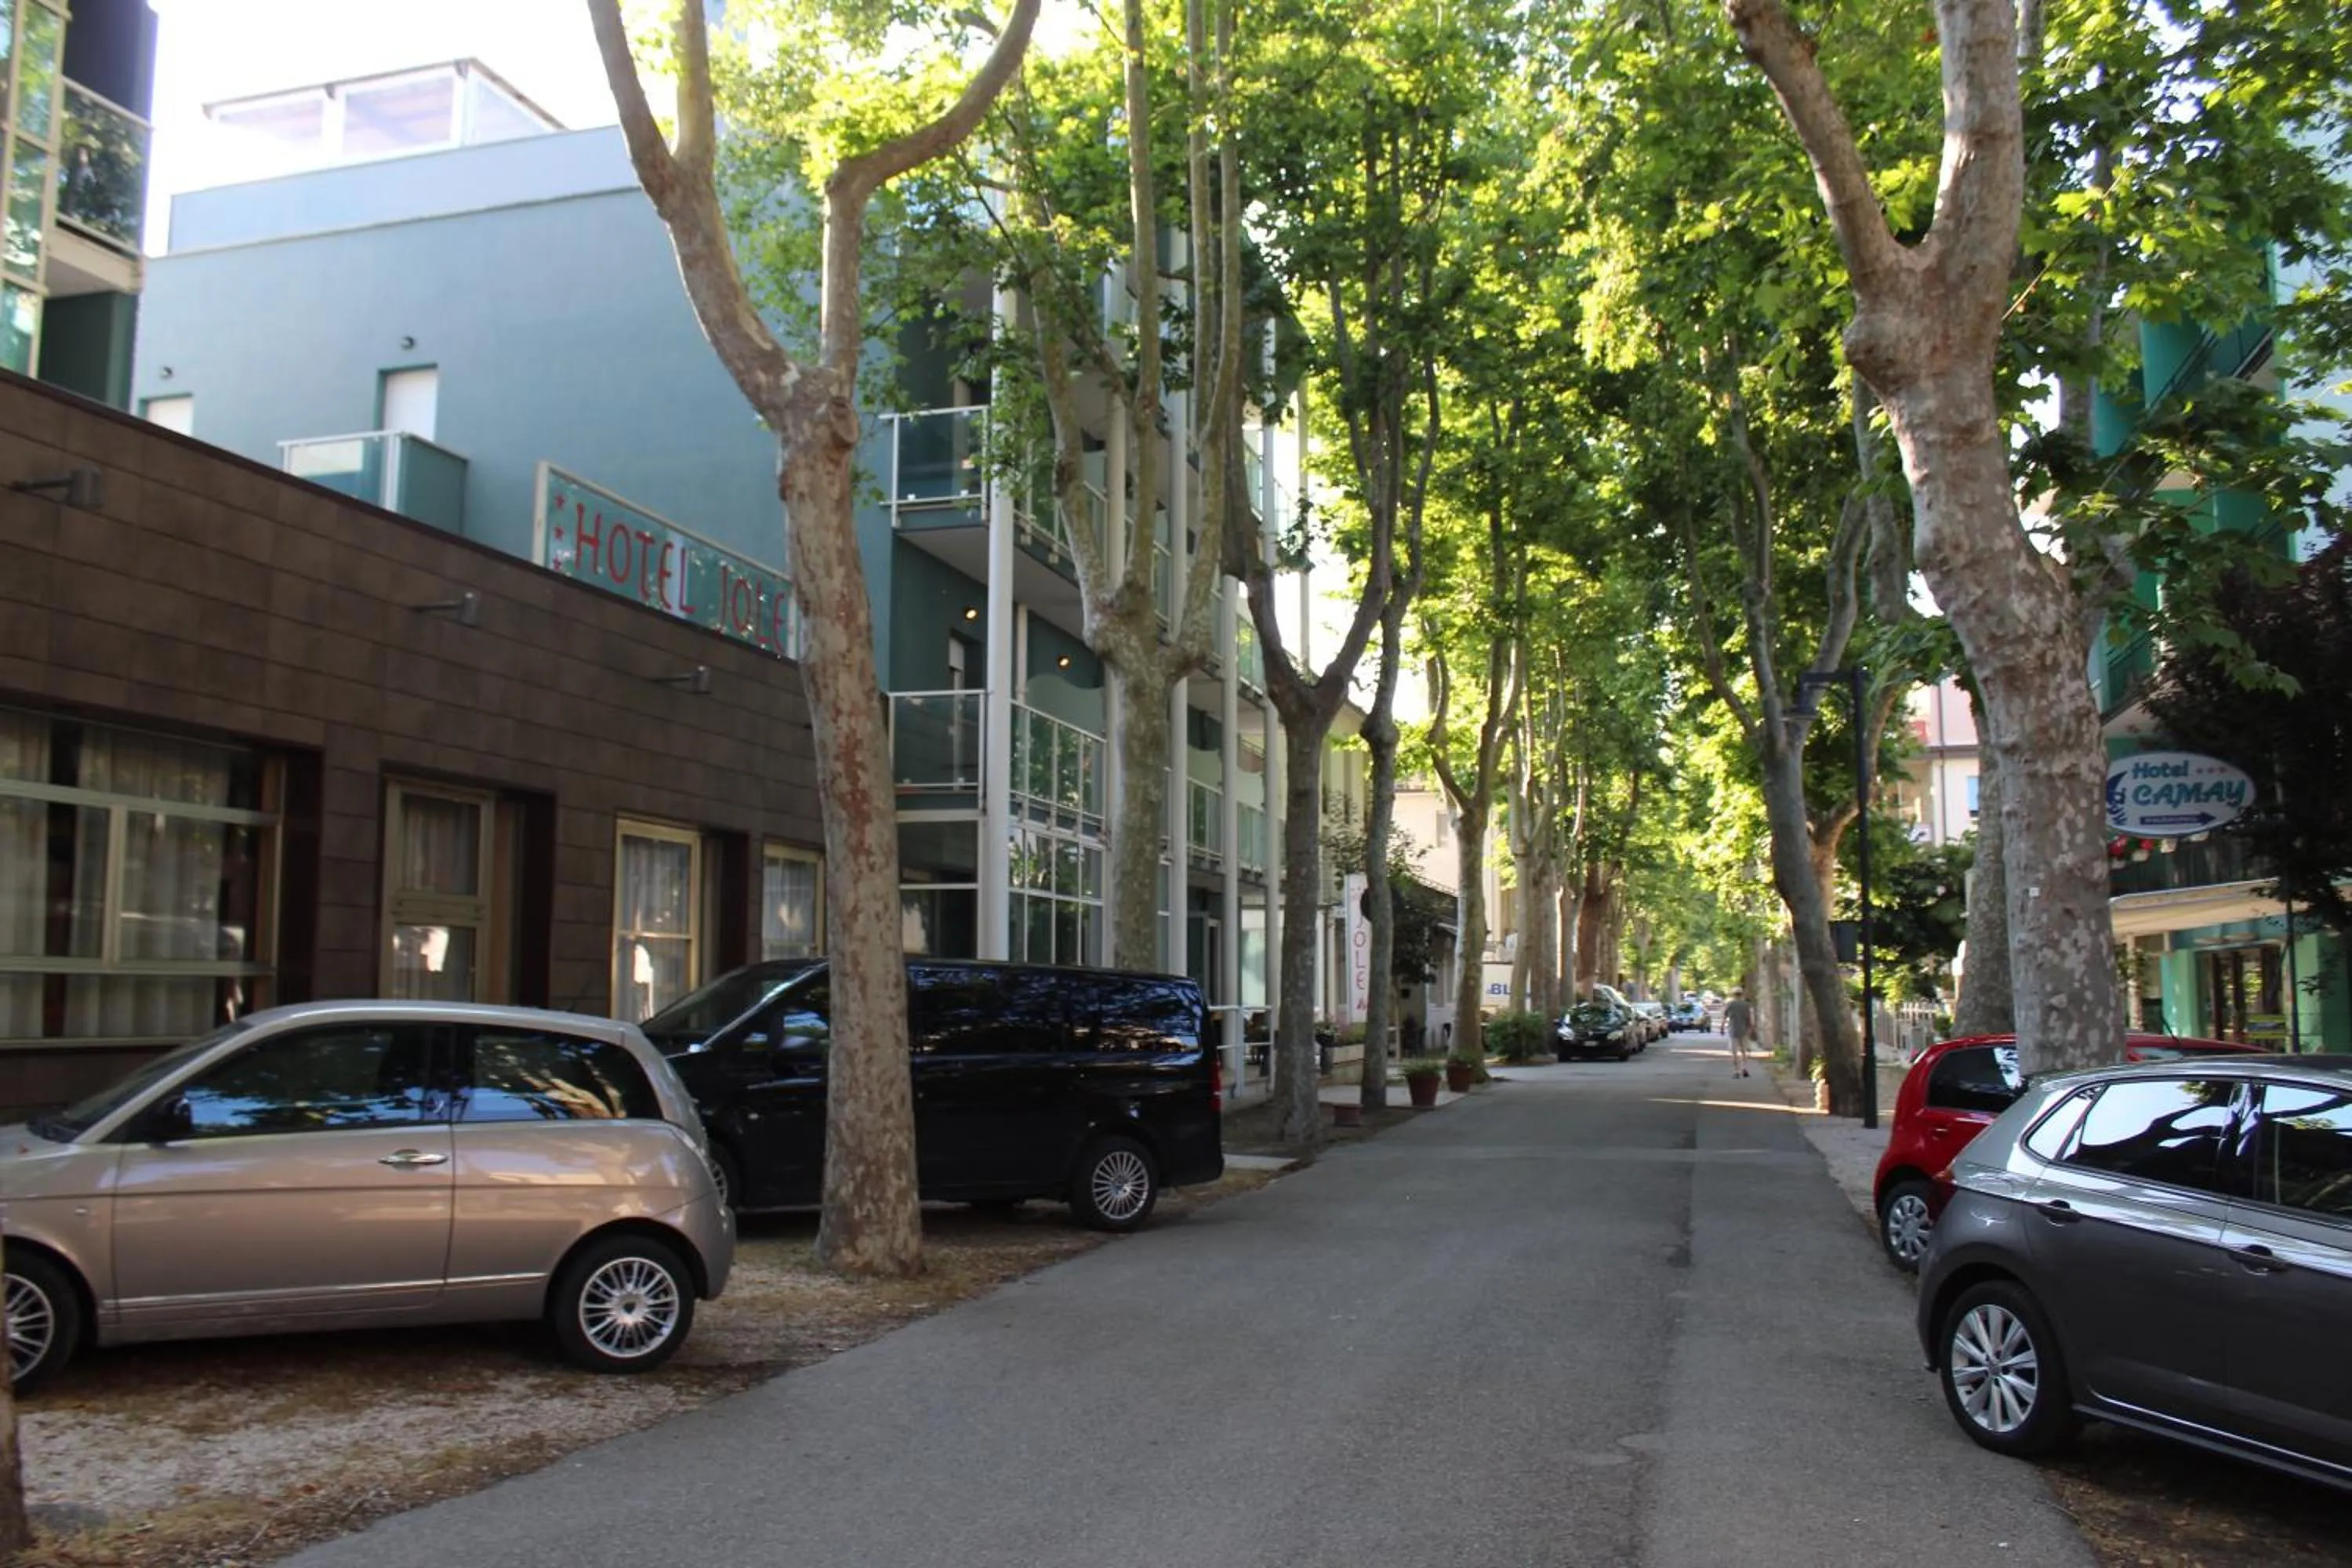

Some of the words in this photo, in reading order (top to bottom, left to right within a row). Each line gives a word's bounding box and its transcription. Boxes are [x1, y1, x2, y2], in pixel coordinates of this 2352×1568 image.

[575, 502, 696, 615] HOTEL
[2132, 759, 2189, 779] Hotel
[2132, 779, 2246, 808] CAMAY
